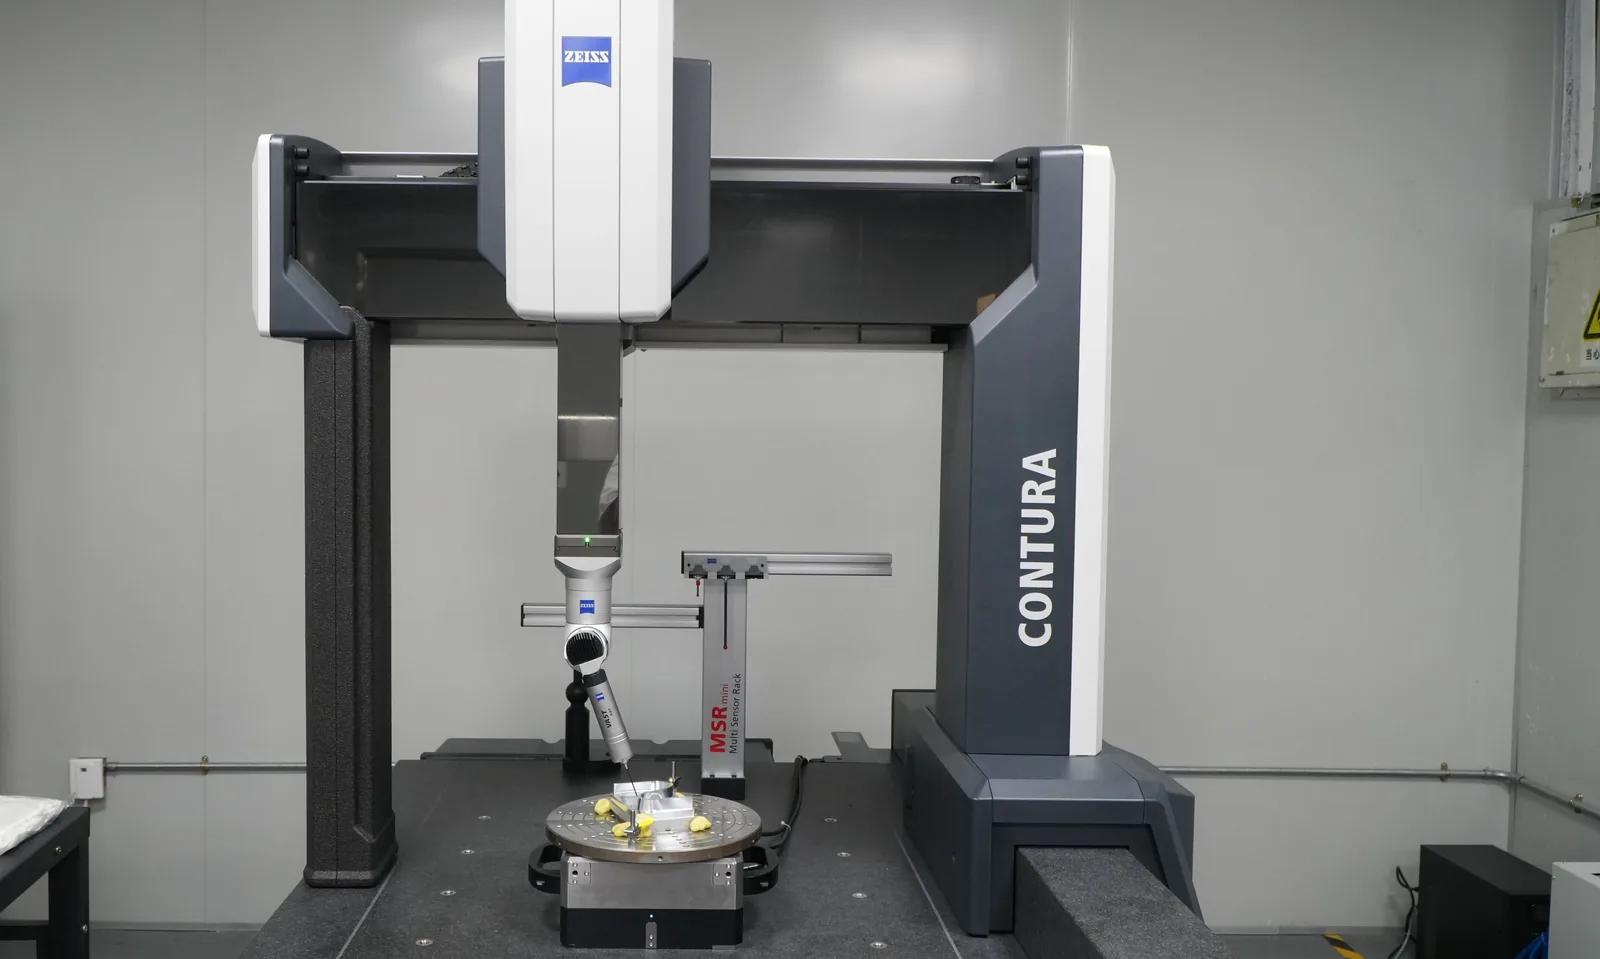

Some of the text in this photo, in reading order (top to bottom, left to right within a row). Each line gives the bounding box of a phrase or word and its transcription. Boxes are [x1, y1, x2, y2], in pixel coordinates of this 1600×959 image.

[564, 50, 609, 63] ZEISS
[1018, 448, 1057, 647] CONTURA
[601, 710, 612, 729] VAST
[709, 684, 728, 753] MSR mini
[729, 673, 742, 753] Multi Sensor Rack
